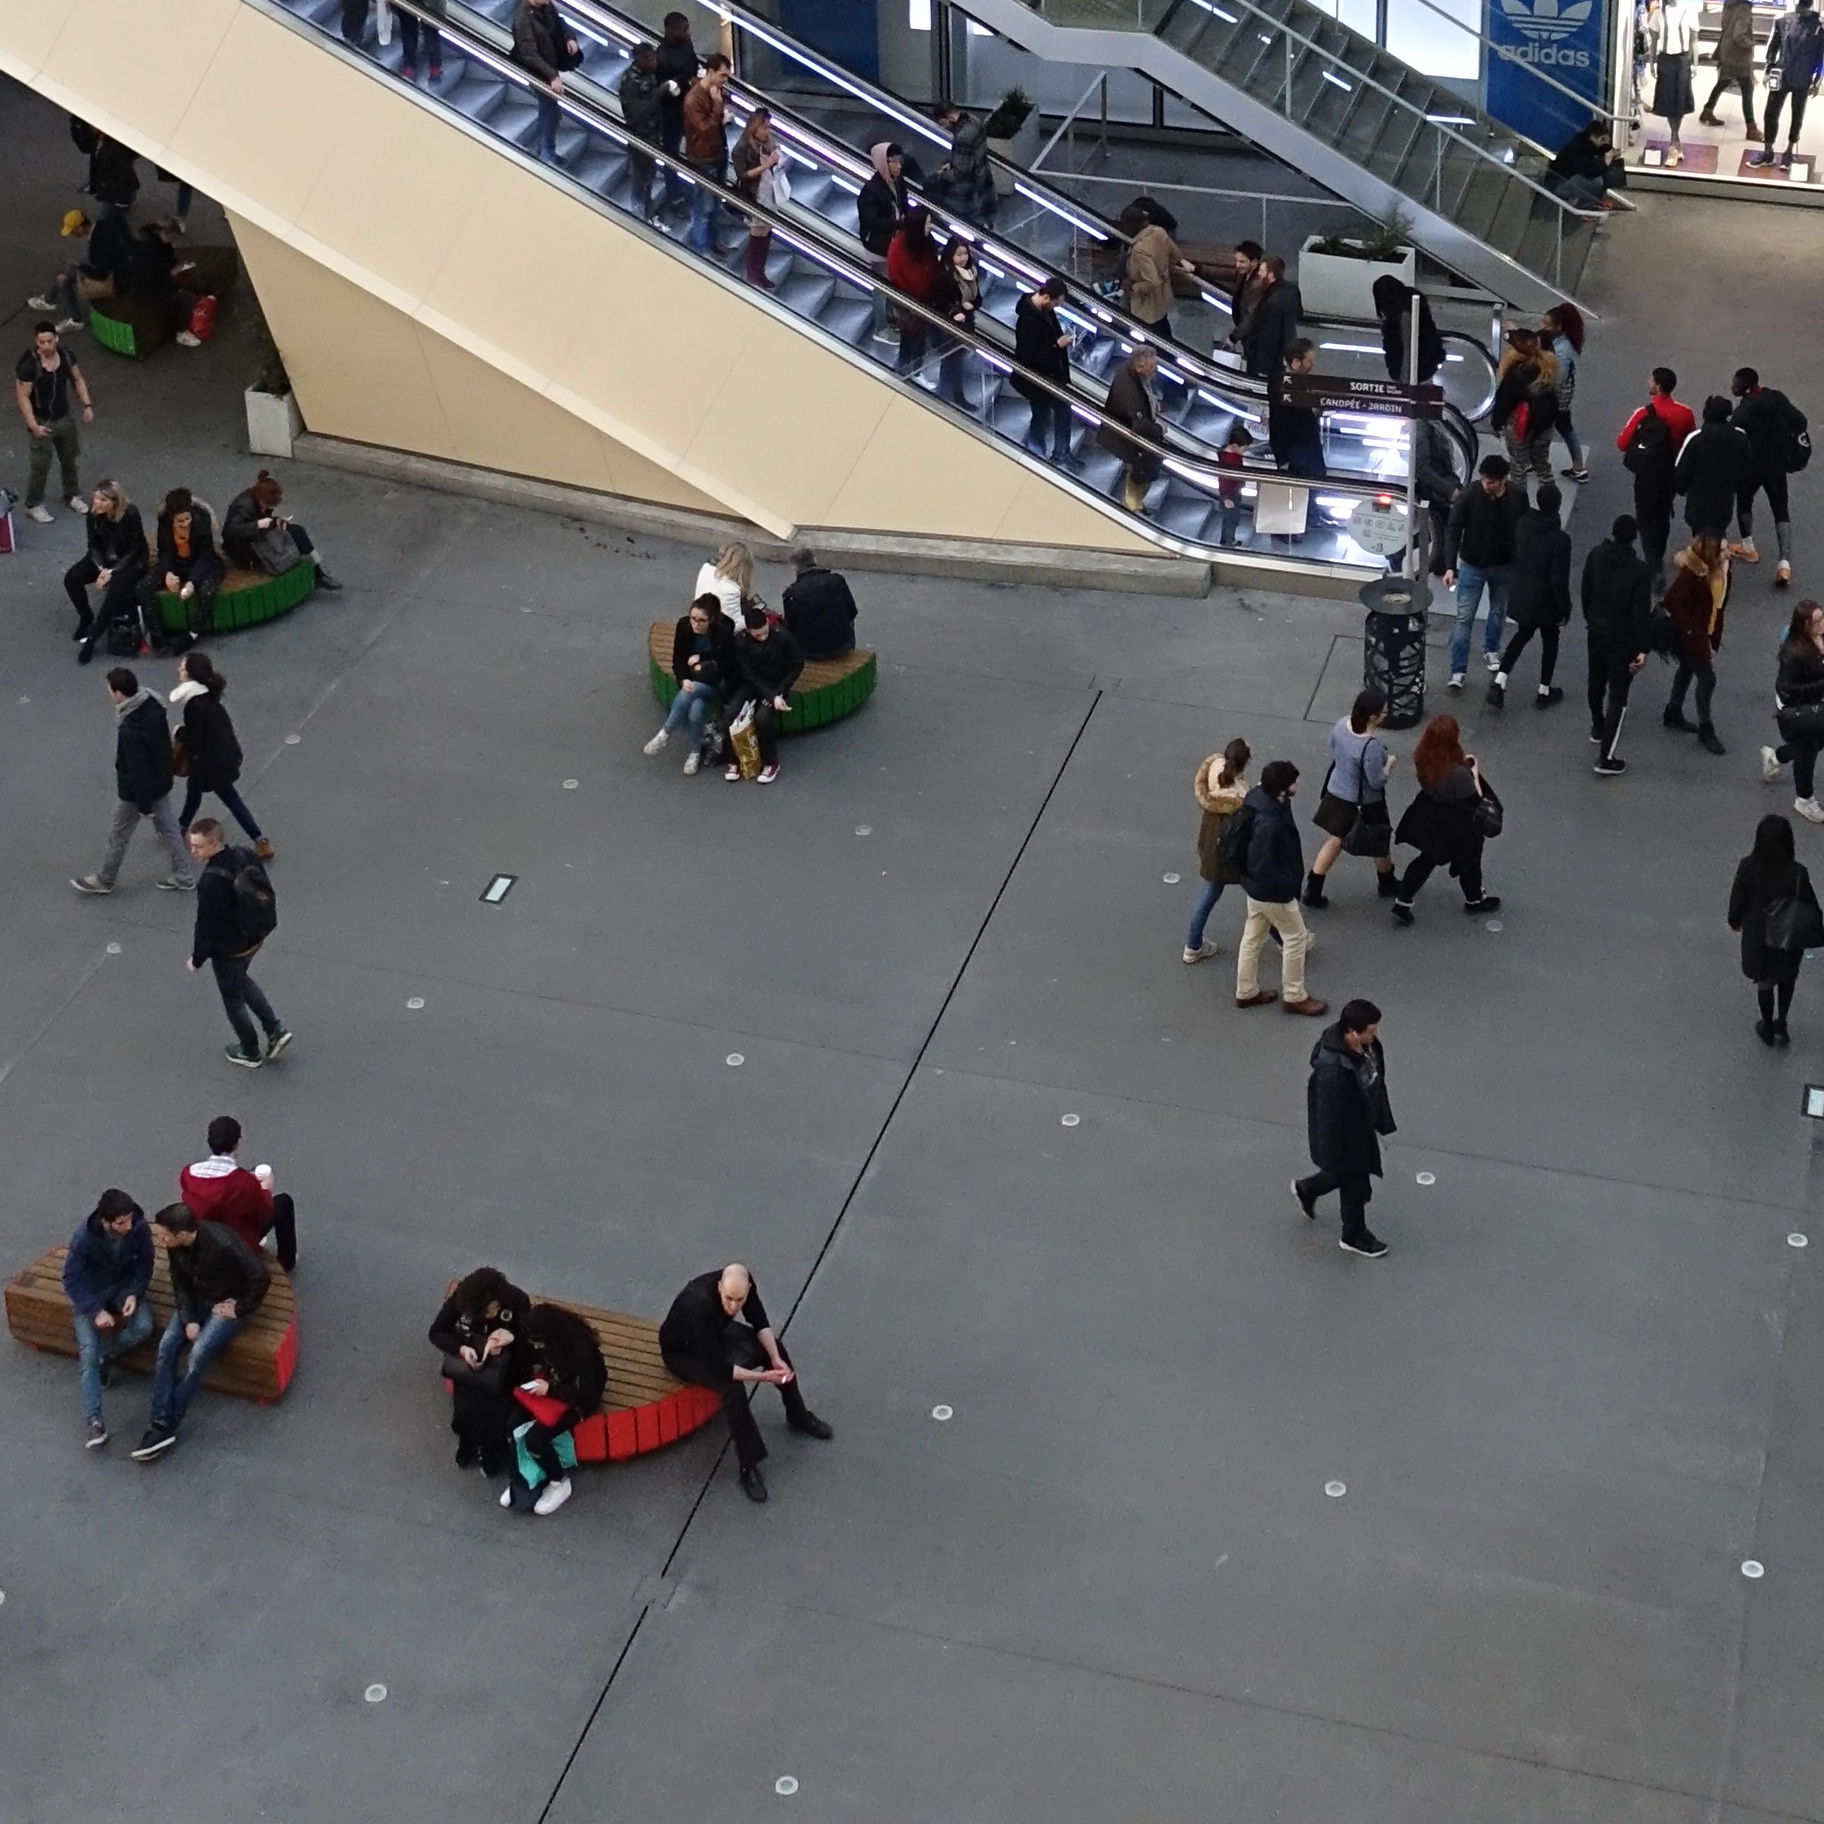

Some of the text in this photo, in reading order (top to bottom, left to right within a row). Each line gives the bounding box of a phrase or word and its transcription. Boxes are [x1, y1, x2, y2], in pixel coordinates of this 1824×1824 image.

[1498, 41, 1591, 68] adidas
[1349, 381, 1385, 394] SORTIE
[1319, 397, 1361, 410] CANOPÉE
[1368, 401, 1403, 413] JARDIN
